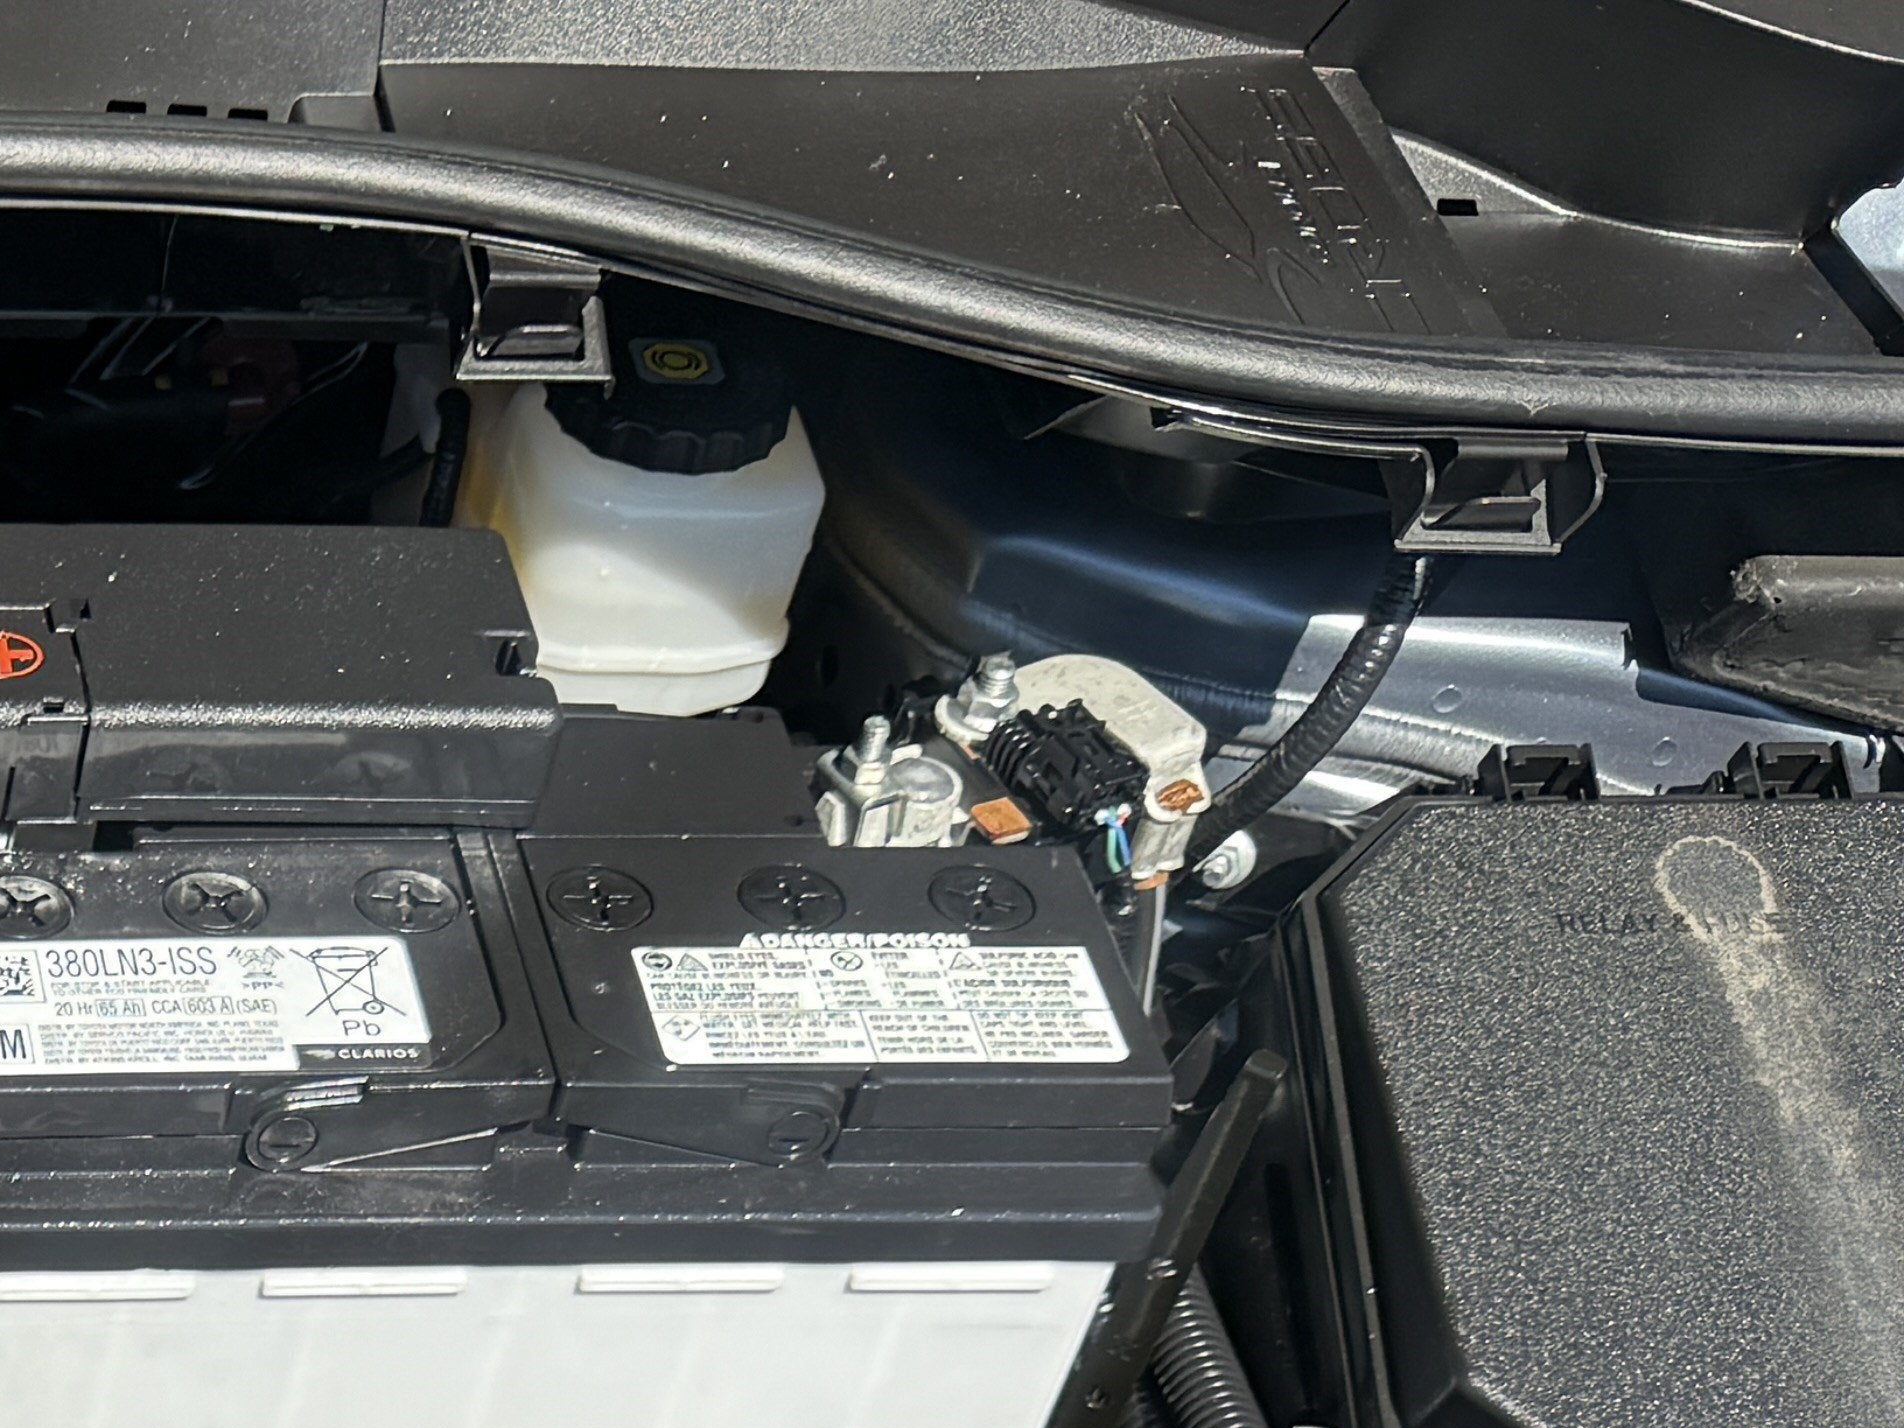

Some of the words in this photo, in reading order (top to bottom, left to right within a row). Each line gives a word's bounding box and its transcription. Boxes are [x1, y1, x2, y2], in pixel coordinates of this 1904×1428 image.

[45, 946, 217, 978] 380LN3-ISS
[55, 1001, 73, 1016] 20
[100, 1001, 118, 1015] 65
[151, 999, 182, 1015] CCA
[186, 998, 216, 1014] 603
[236, 998, 277, 1015] (SAE)
[342, 1019, 381, 1036] Pb
[338, 1049, 420, 1060] CLARIOS
